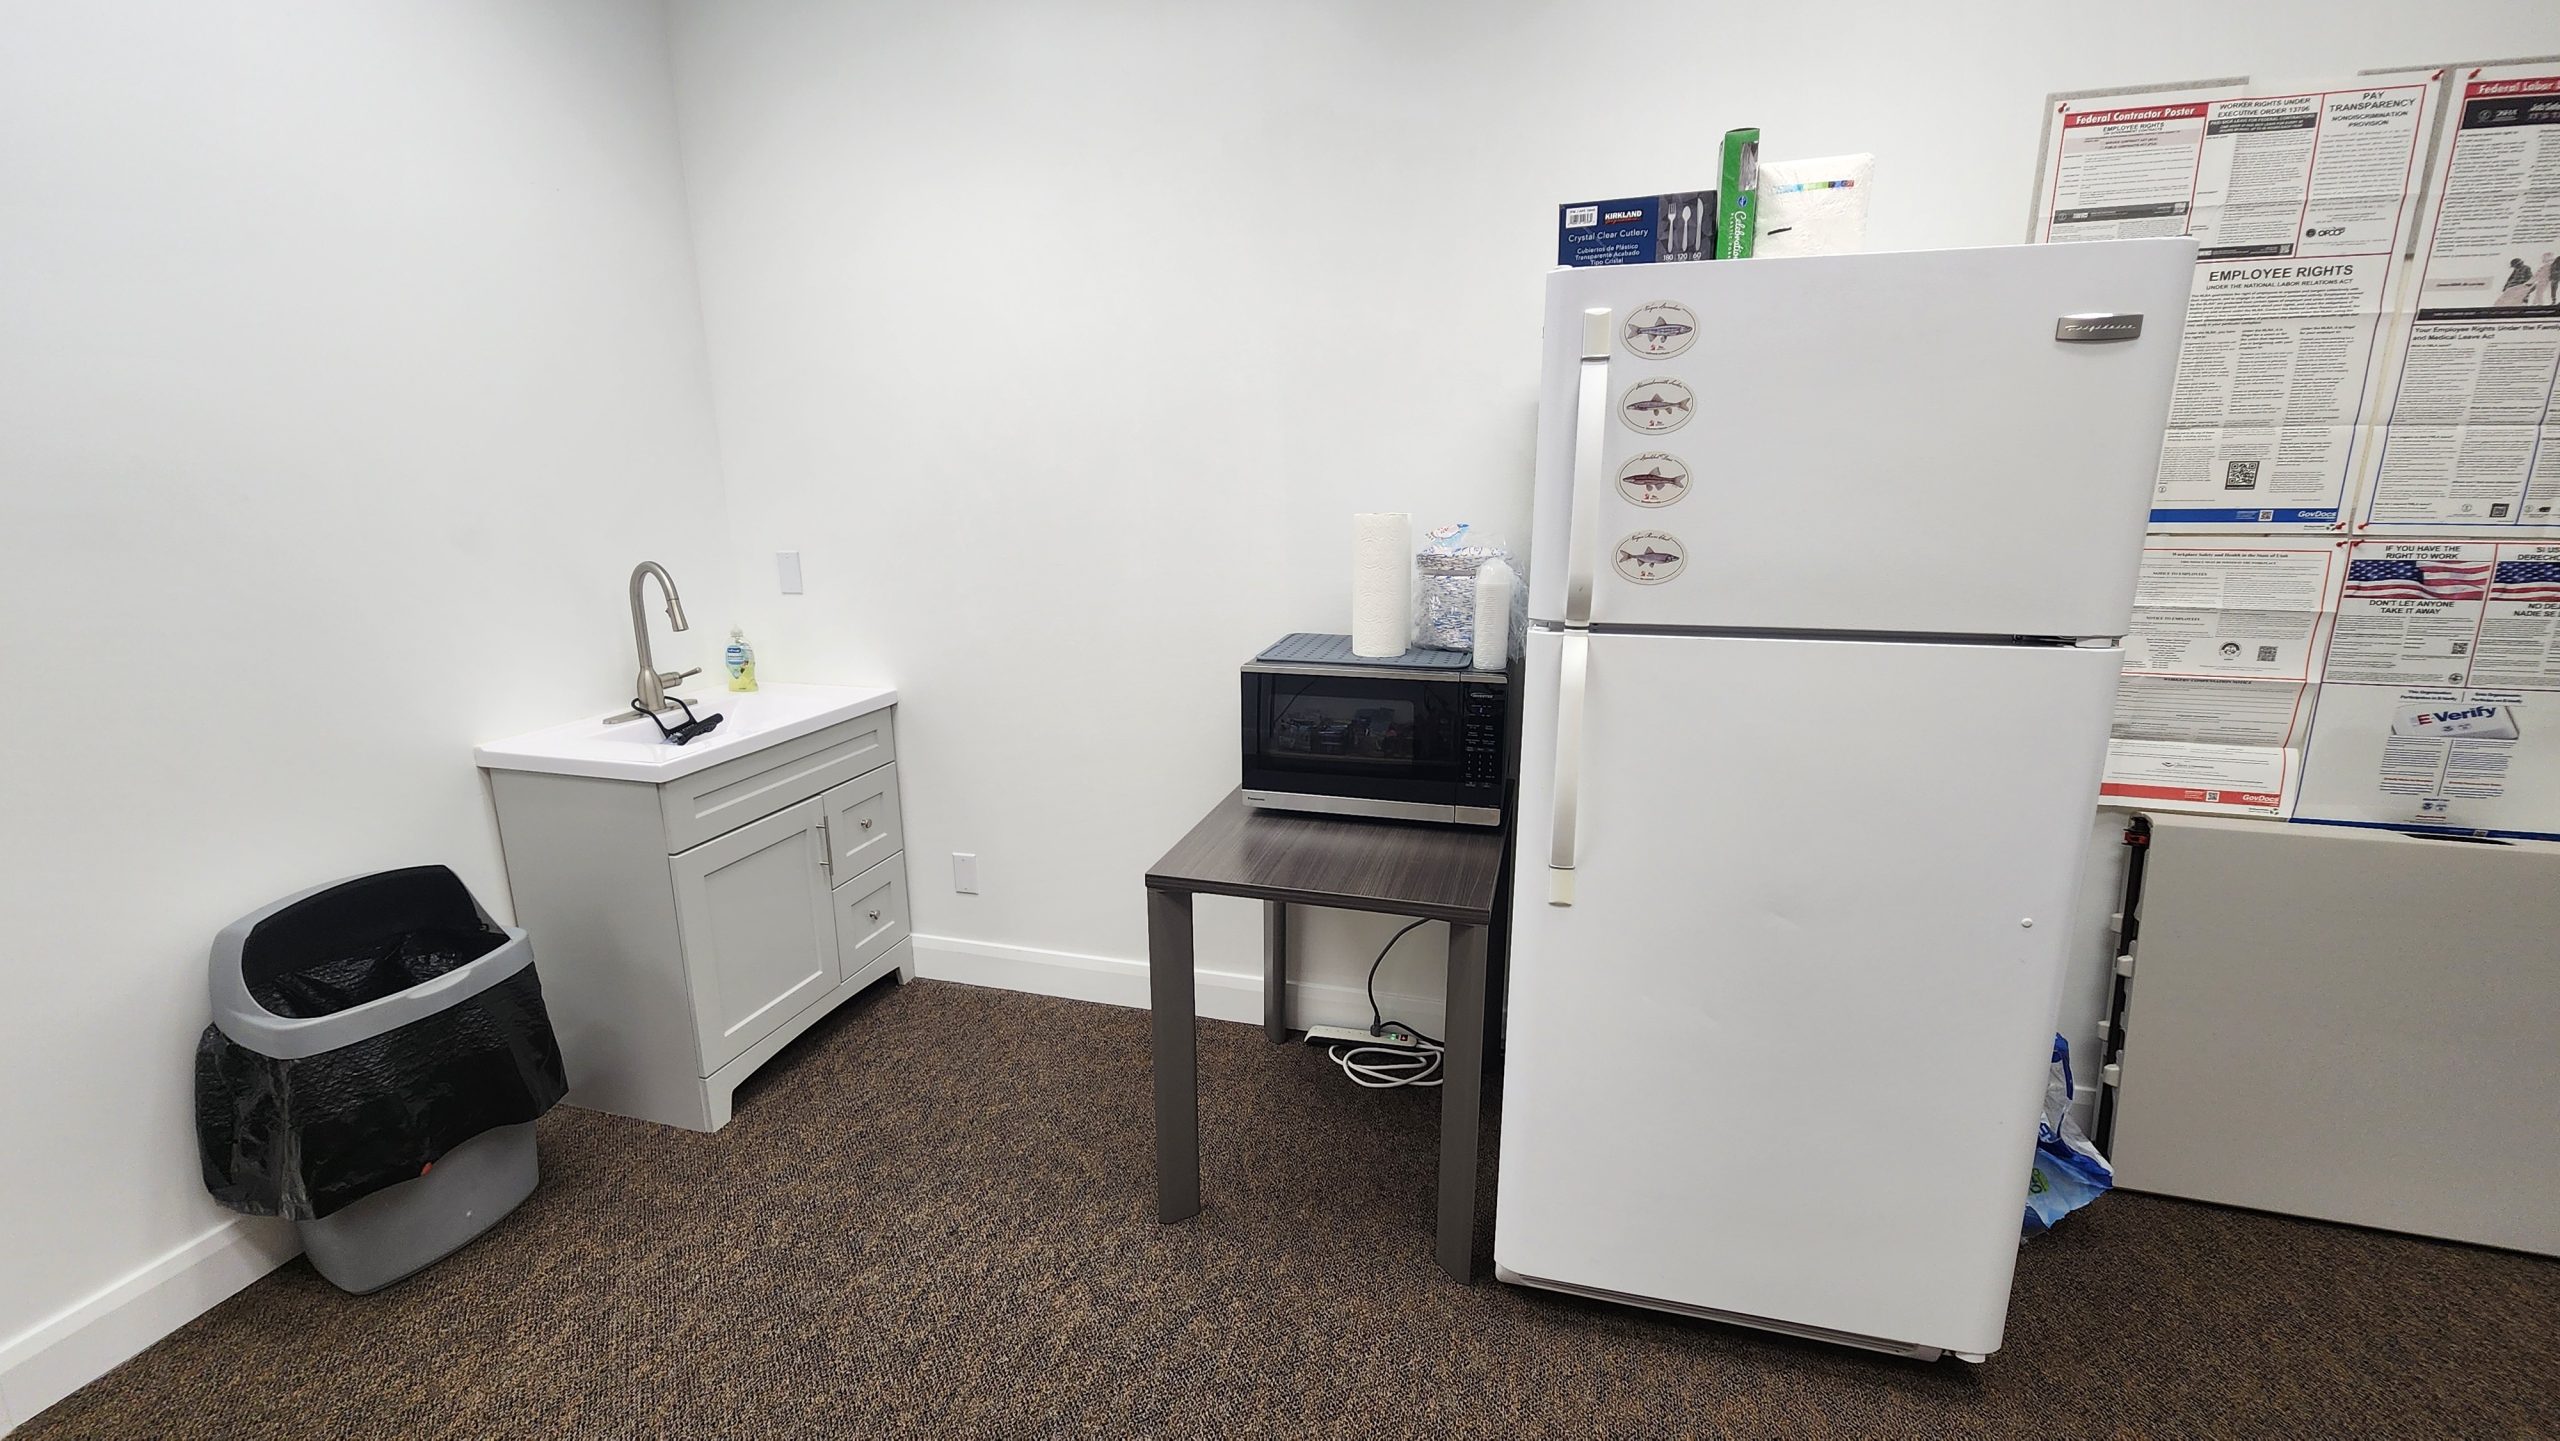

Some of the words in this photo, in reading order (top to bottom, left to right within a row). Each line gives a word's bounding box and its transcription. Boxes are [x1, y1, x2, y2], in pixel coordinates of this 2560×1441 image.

[2479, 82, 2520, 95] Federal
[2523, 80, 2555, 92] Labor
[2363, 91, 2385, 100] PAY
[2220, 101, 2252, 110] WORKER
[2254, 99, 2282, 107] RIGHTS
[2284, 98, 2312, 106] UNDER
[2329, 98, 2416, 112] TRANSPARENCY
[2076, 112, 2111, 125] Federal
[2113, 108, 2161, 122] Contractor
[2164, 106, 2195, 117] Poster
[2217, 110, 2258, 118] EXECUTIVE
[2260, 107, 2287, 115] ORDER
[2103, 124, 2138, 132] EMPLOYEE
[1604, 210, 1643, 220] KIRKLAND
[1568, 232, 1595, 243] Crystal
[1597, 231, 1618, 240] Clear
[1619, 228, 1649, 238] Cutlery
[1613, 249, 1640, 258] Acabado
[2209, 267, 2292, 282] EMPLOYEE
[2296, 265, 2353, 278] RIGHTS
[2416, 600, 2455, 608] ANYONE
